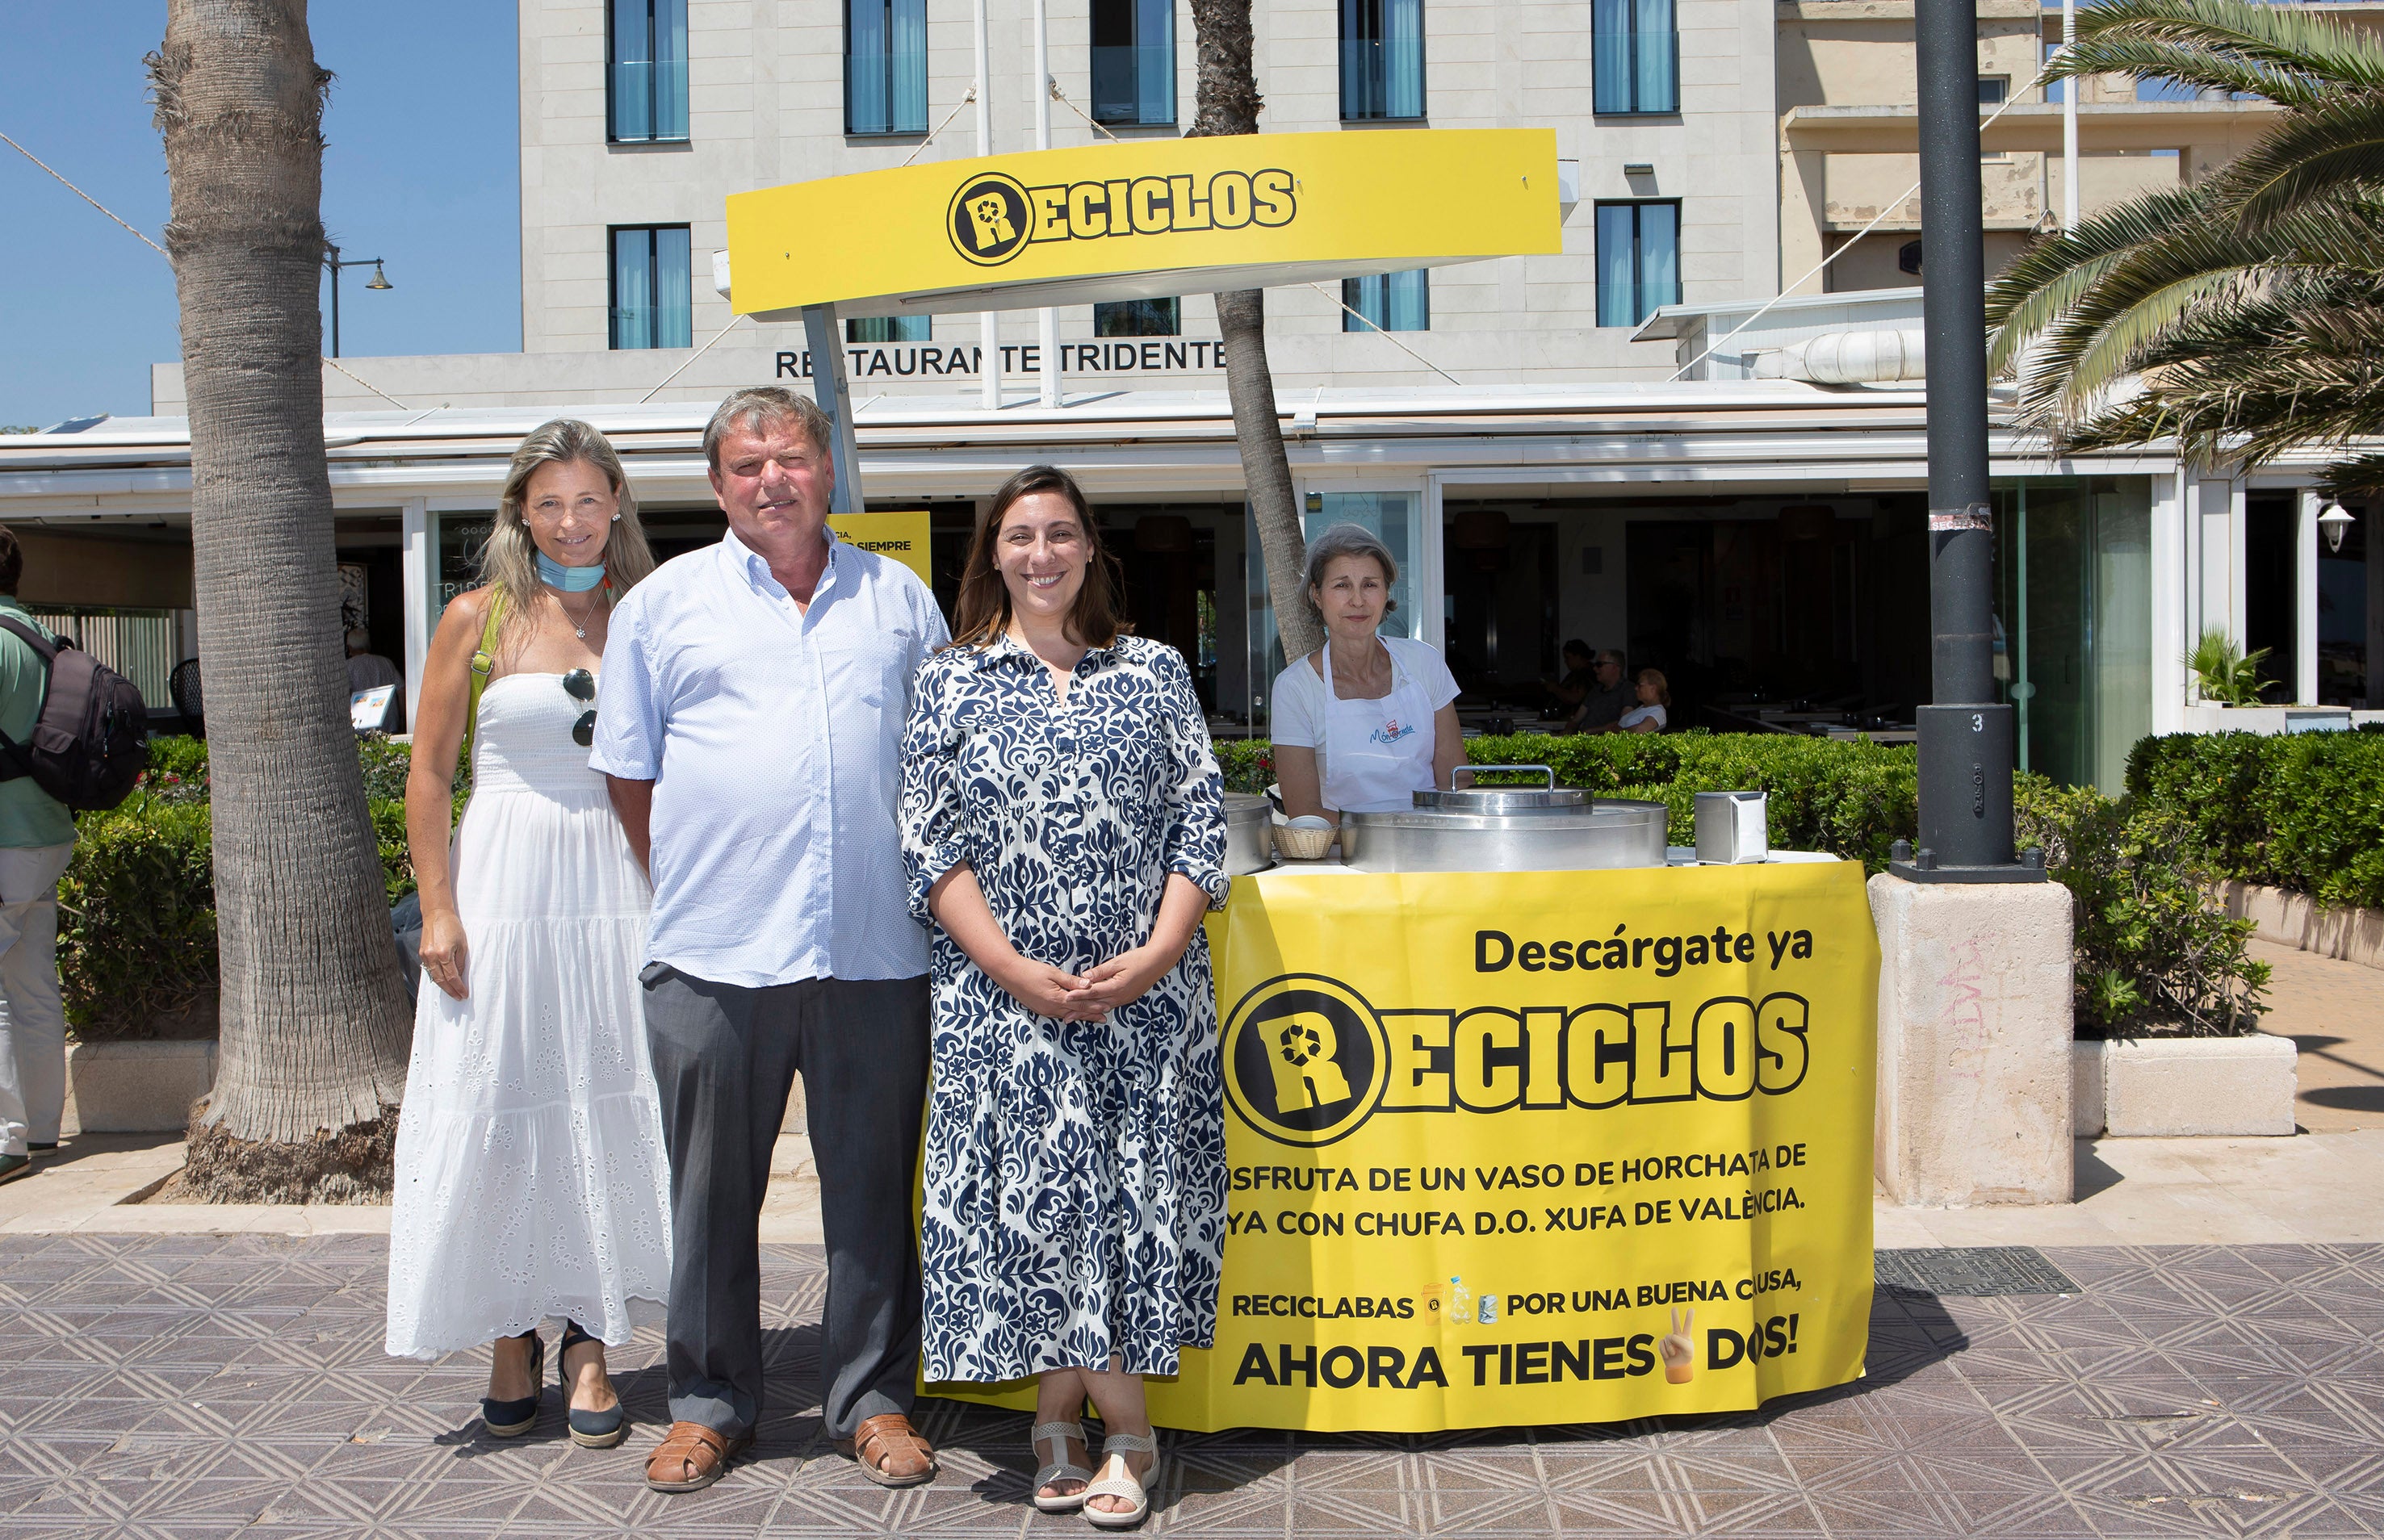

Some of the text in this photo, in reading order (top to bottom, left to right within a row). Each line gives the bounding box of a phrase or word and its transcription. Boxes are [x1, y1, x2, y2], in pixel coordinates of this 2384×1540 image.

[947, 169, 1297, 267] RECICLOS
[776, 341, 1227, 379] RETAURATE TRIDENTE
[836, 531, 851, 539] CIA,
[857, 541, 911, 551] SIEMPRE
[1972, 714, 1983, 732] 3
[1476, 923, 1813, 977] Descárgate ya
[1218, 973, 1810, 1148] RECICLOS
[1227, 1143, 1807, 1192] ISFRUTA DE UN VASO DE HORCHATA DE
[1226, 1187, 1805, 1237] YA CON CHUFA D.O. XUFA DE VALÈNCIA.
[1233, 1295, 1414, 1319] RECICLABAS
[1507, 1293, 1565, 1316] POR
[1572, 1288, 1632, 1312] UNA
[1637, 1280, 1729, 1308] BUENA
[1233, 1312, 1800, 1389] AHORA TIENES DOS!
